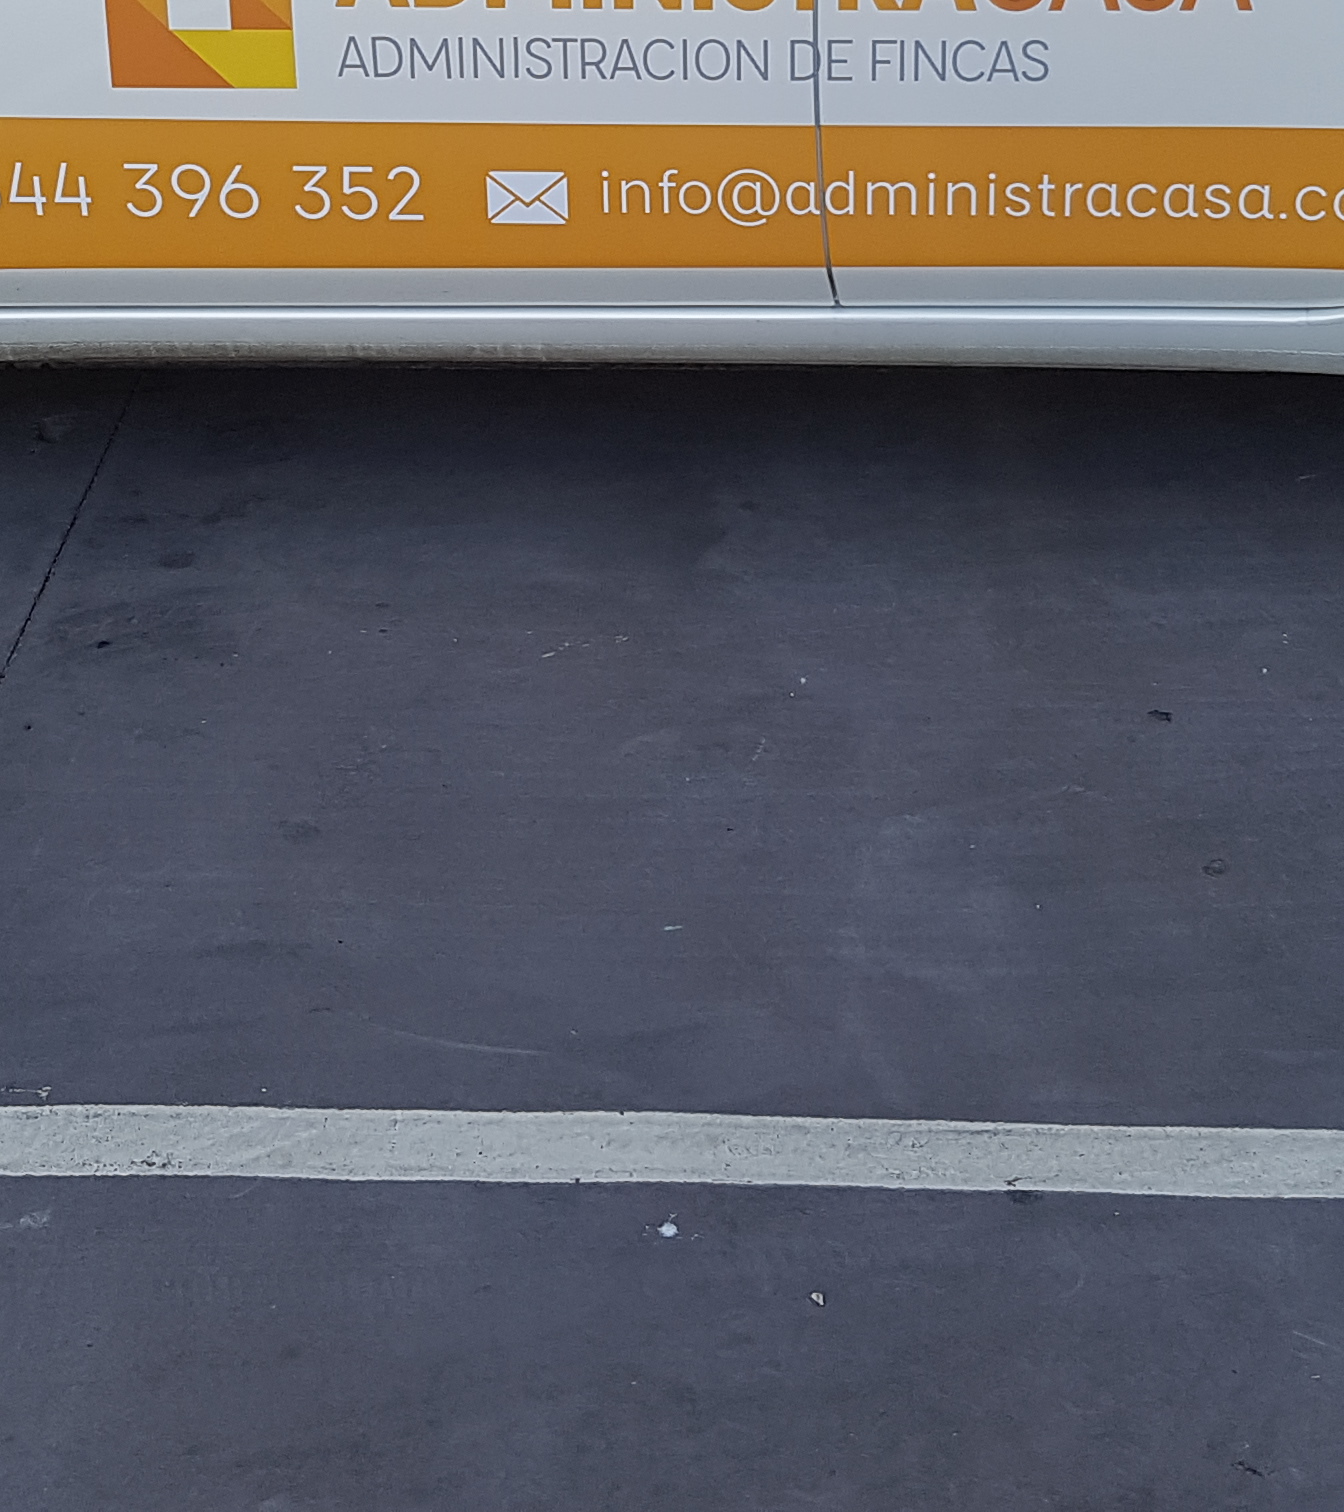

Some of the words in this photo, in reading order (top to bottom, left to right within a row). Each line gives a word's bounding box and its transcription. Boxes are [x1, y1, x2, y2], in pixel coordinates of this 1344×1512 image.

[337, 35, 770, 82] ADMINISTRACION
[789, 39, 854, 82] DE
[871, 39, 1050, 83] FINCAS
[122, 162, 260, 220] 396
[291, 164, 425, 222] 352
